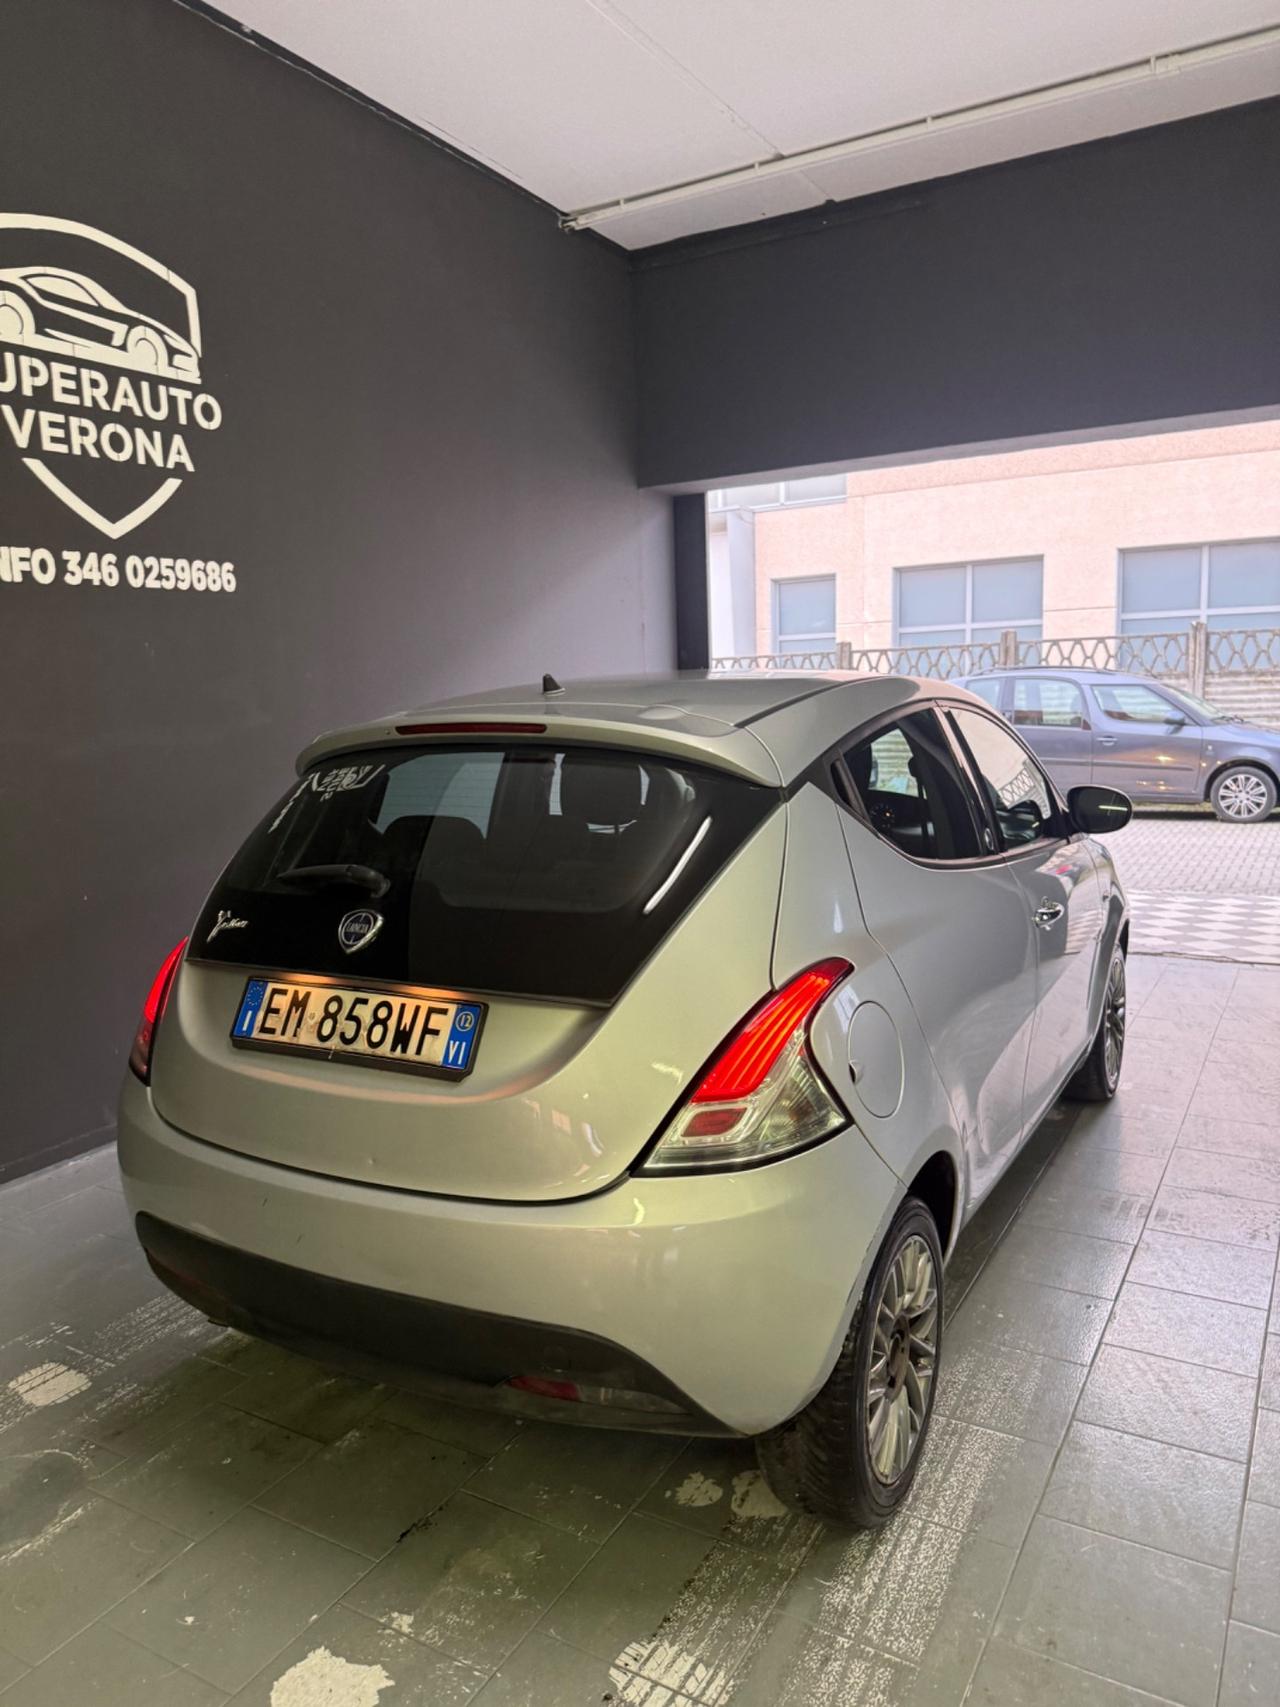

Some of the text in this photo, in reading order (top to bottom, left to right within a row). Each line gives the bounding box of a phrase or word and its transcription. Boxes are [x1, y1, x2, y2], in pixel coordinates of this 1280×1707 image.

[0, 352, 222, 430] UPERAUTO
[1, 404, 195, 472] VERONA
[0, 546, 237, 592] NFO 346 0259686
[258, 988, 311, 1037] EM
[448, 1040, 467, 1065] VI
